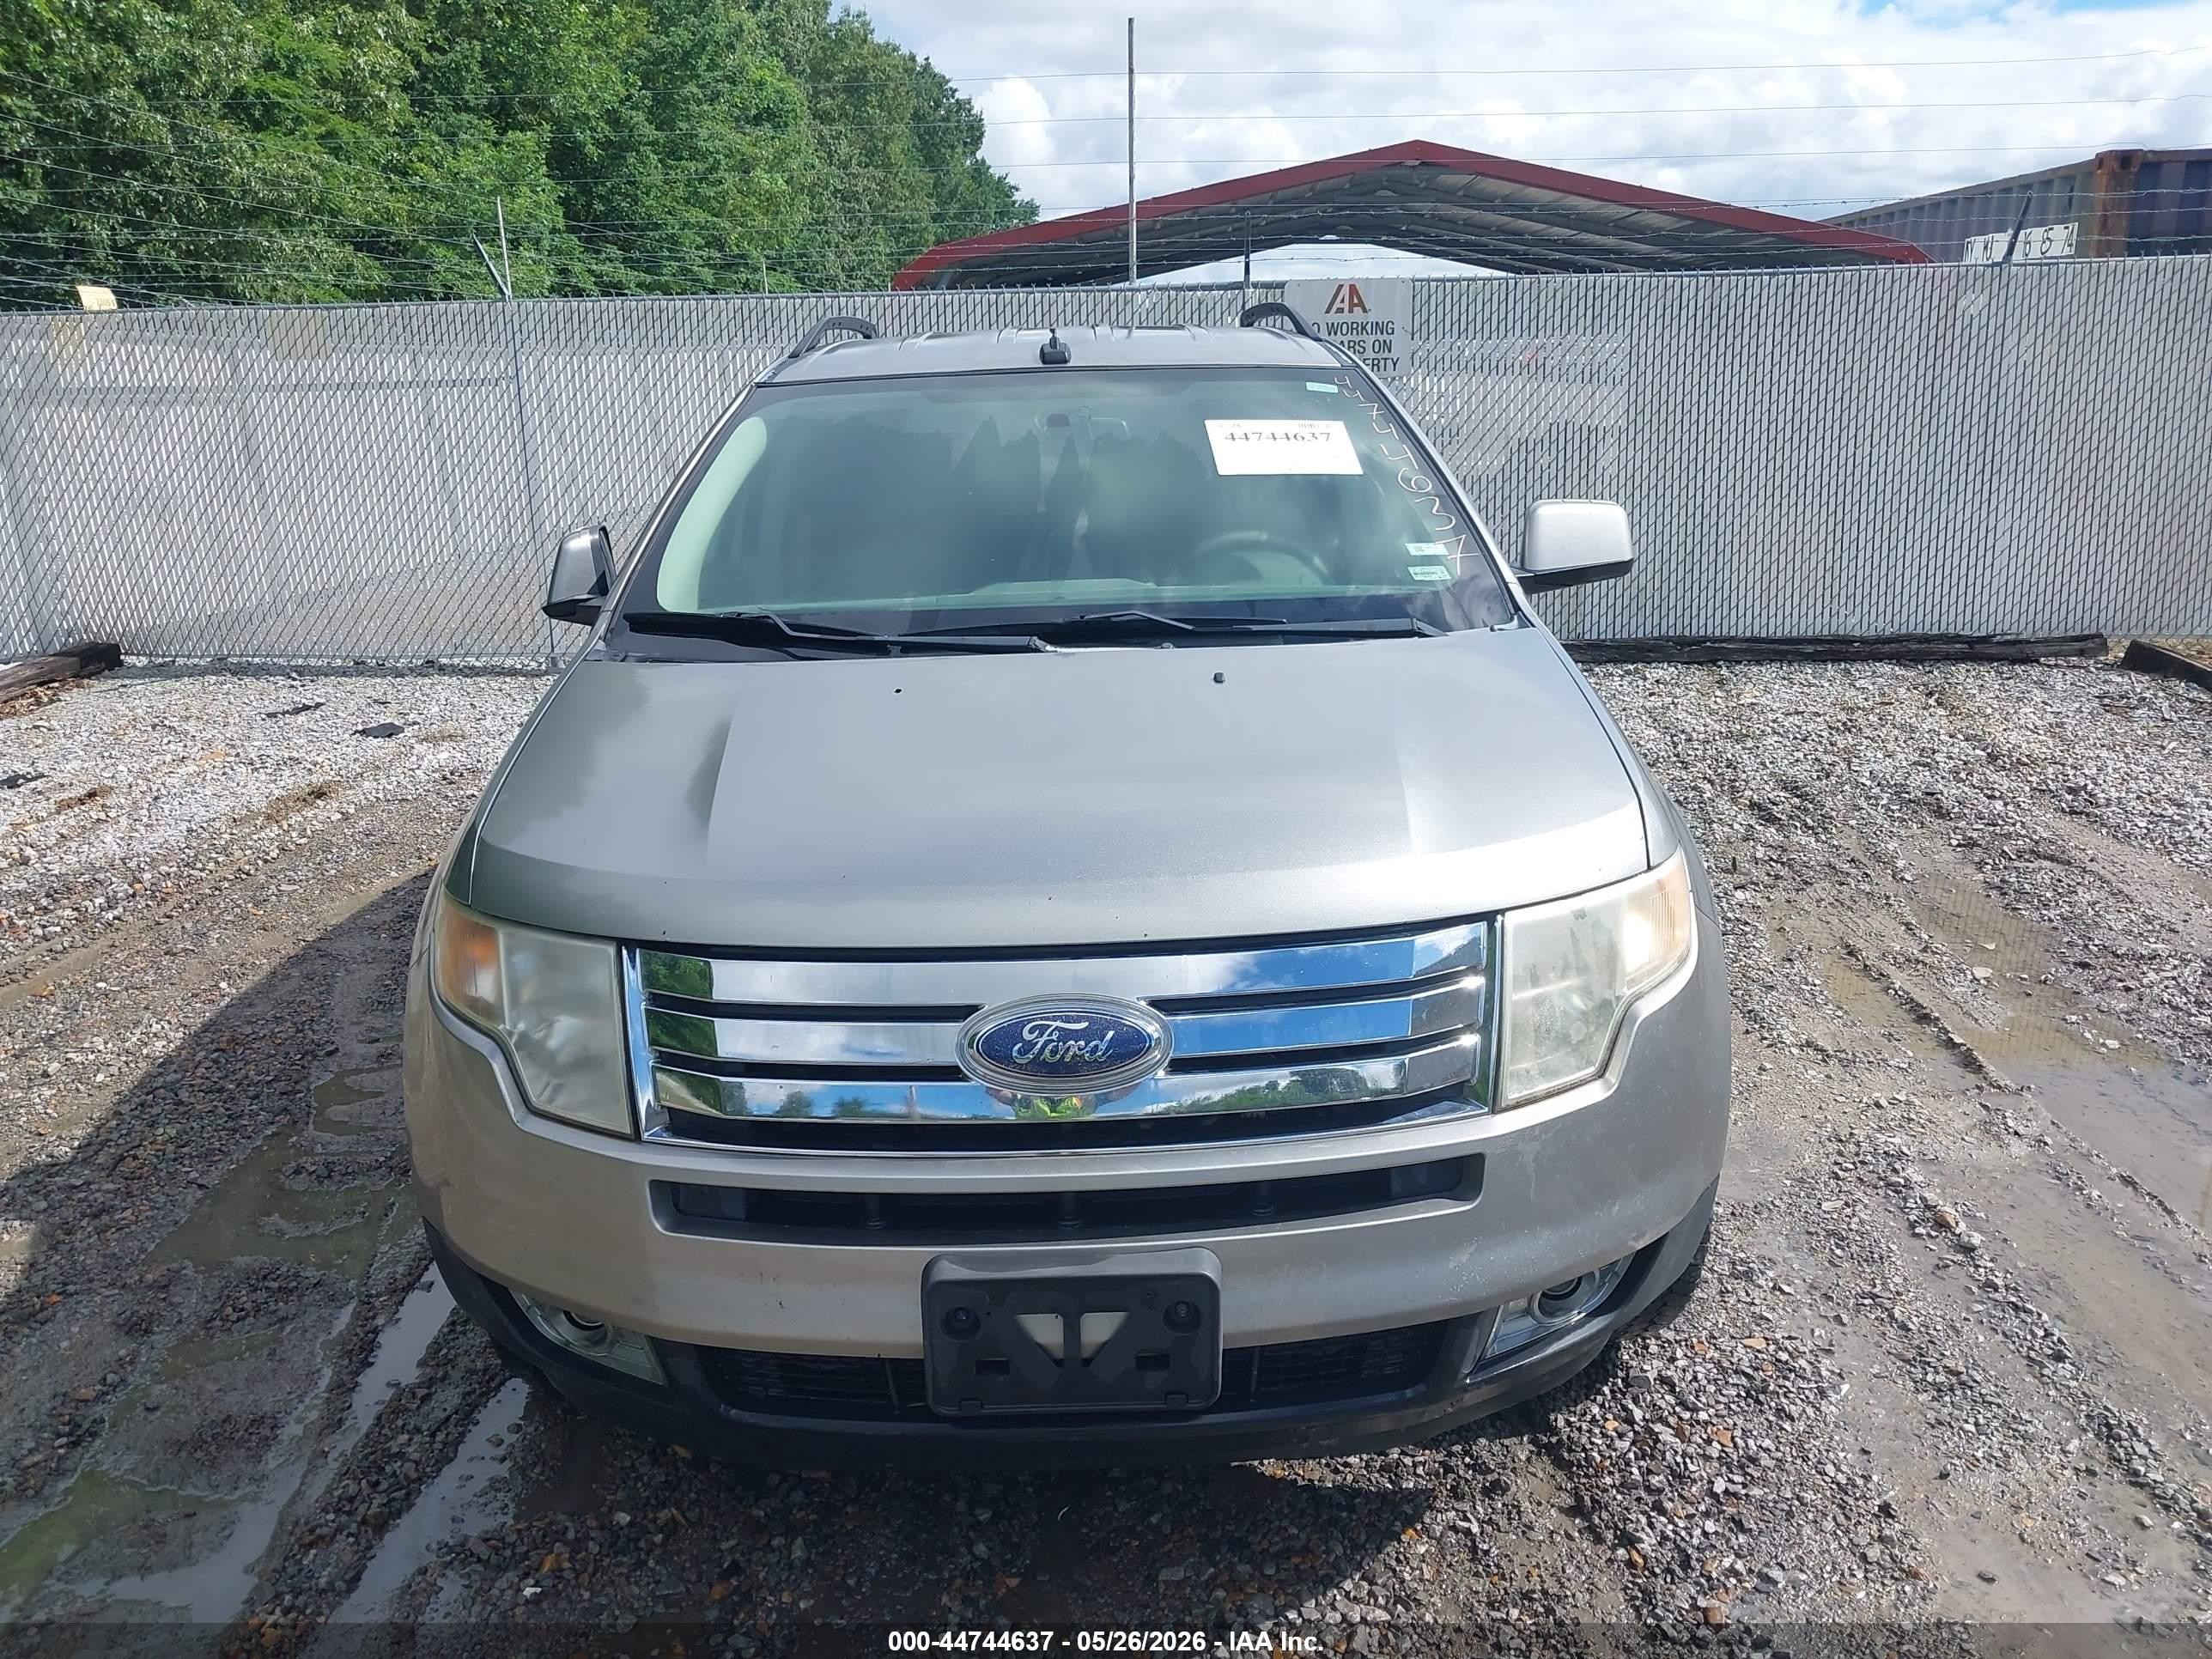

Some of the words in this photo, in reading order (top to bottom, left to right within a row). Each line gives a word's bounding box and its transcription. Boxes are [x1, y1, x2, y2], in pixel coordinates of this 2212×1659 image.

[1326, 320, 1395, 337] WORKING
[1372, 338, 1392, 354] ON
[1224, 432, 1331, 442] 44744637
[1012, 1020, 1115, 1065] Ford
